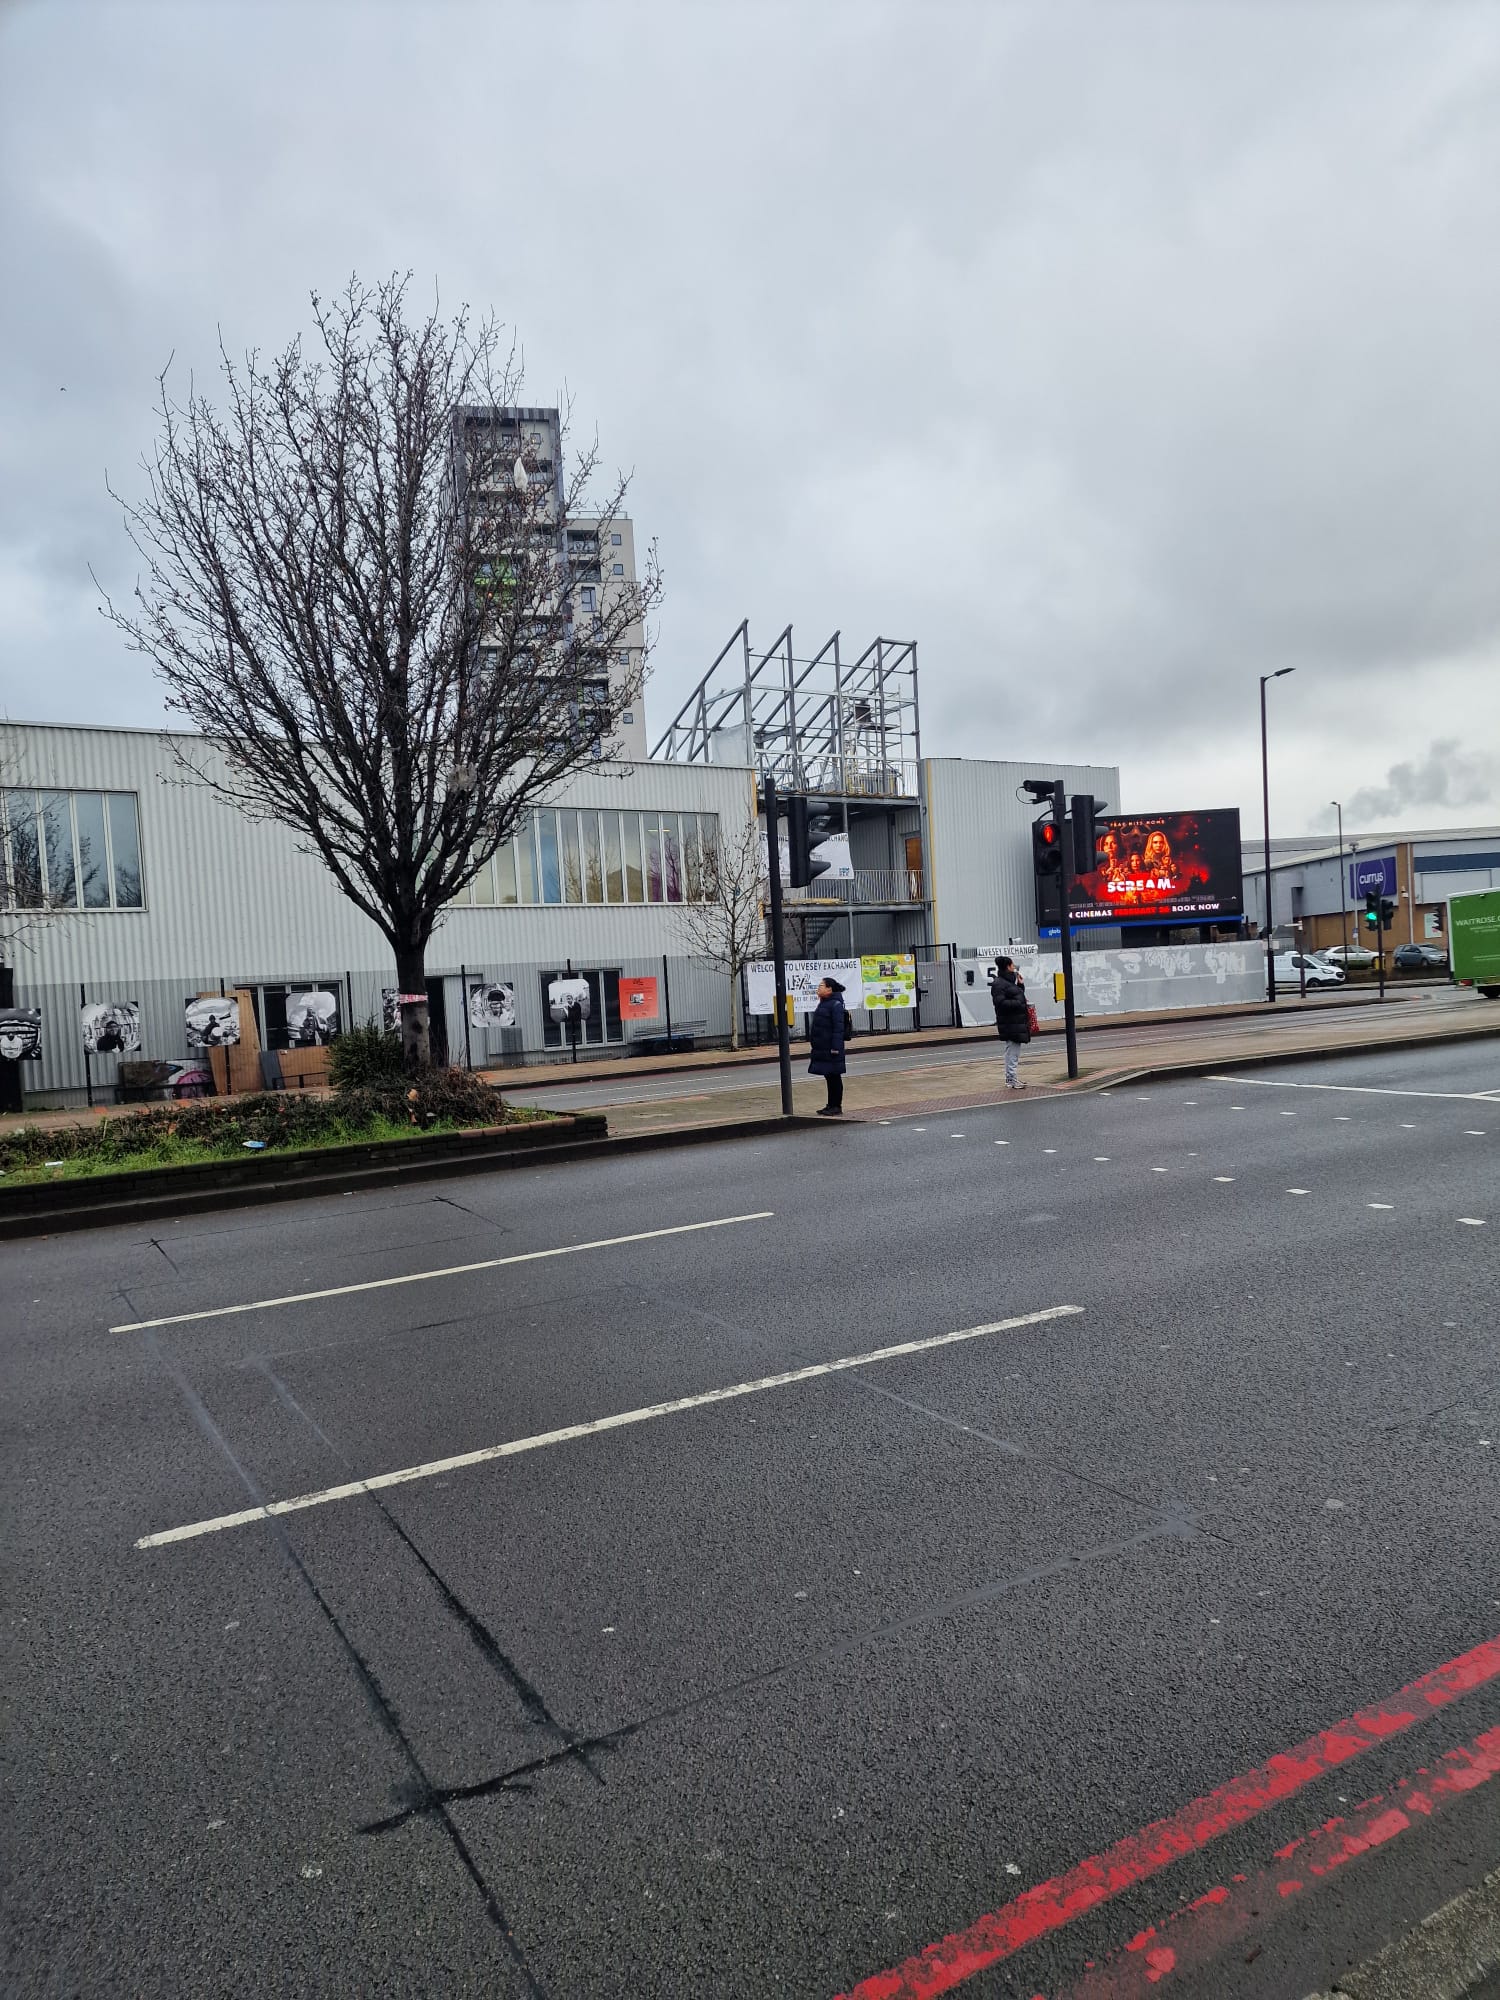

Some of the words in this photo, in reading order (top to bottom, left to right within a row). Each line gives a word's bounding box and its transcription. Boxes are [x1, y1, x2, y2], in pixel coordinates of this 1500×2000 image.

[1359, 871, 1384, 884] currys
[1075, 909, 1112, 919] CINEMAS
[1172, 904, 1196, 912] BOOK
[1198, 903, 1220, 911] NOW
[1455, 915, 1497, 927] WAITROSE
[1048, 928, 1061, 937] glob
[978, 947, 1002, 957] LIVESEY
[1003, 945, 1035, 956] EXCHANGE
[750, 964, 775, 973] WELCO
[785, 963, 794, 972] TO
[794, 962, 822, 972] LIVESEY
[823, 960, 858, 970] EXCHANGE
